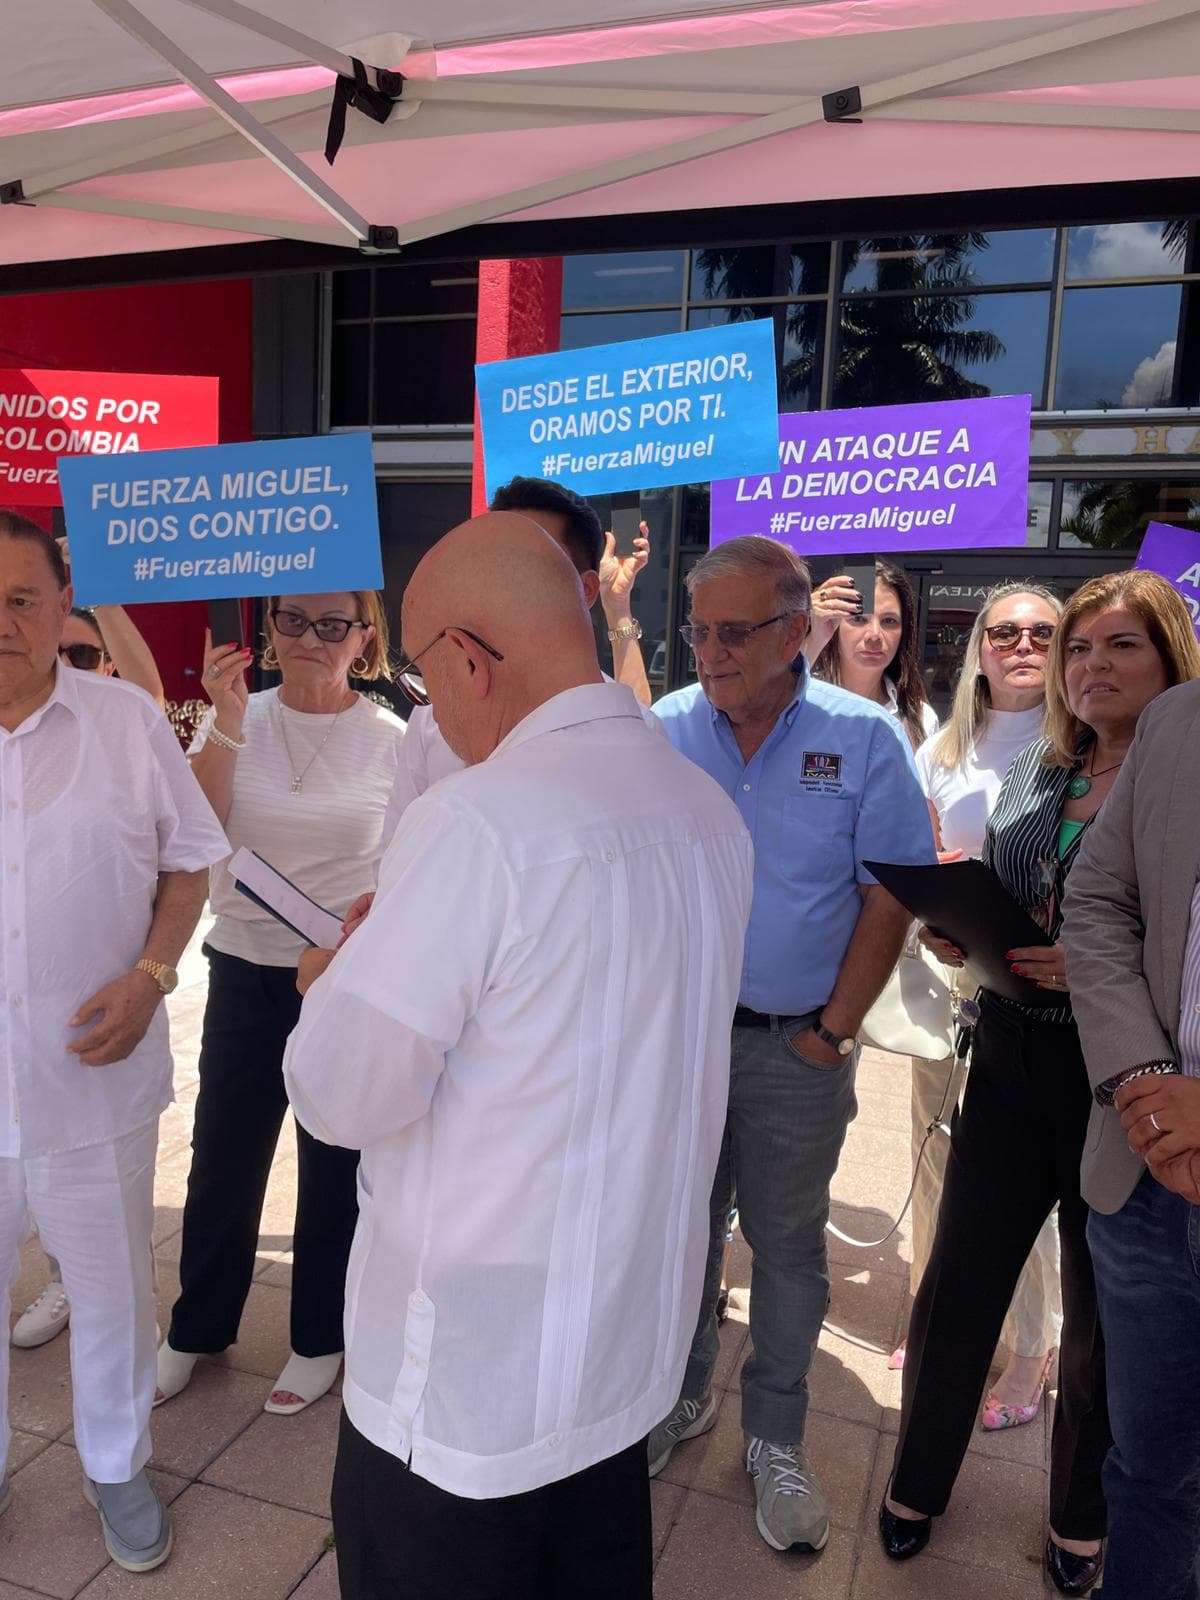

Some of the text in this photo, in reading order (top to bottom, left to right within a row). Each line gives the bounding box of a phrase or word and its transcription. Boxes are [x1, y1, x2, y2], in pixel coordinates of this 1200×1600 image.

[502, 351, 753, 413] DESDE EL EXTERIOR,
[0, 393, 160, 425] NIDOS POR
[529, 392, 727, 443] ORAMOS POR TI.
[0, 426, 140, 454] OLOMBIA
[541, 433, 715, 477] #FuerzaMiguel
[812, 429, 942, 462] ATAQUE
[946, 428, 970, 453] A
[0, 462, 58, 485] Fuerz
[91, 465, 350, 510] FUERZA MIGUEL,
[735, 461, 998, 502] LA DEMOCRACIA
[106, 503, 340, 546] DIOS CONTIGO.
[769, 503, 957, 534] #FuerzaMiguel
[133, 547, 316, 582] #FuerzaMiguel
